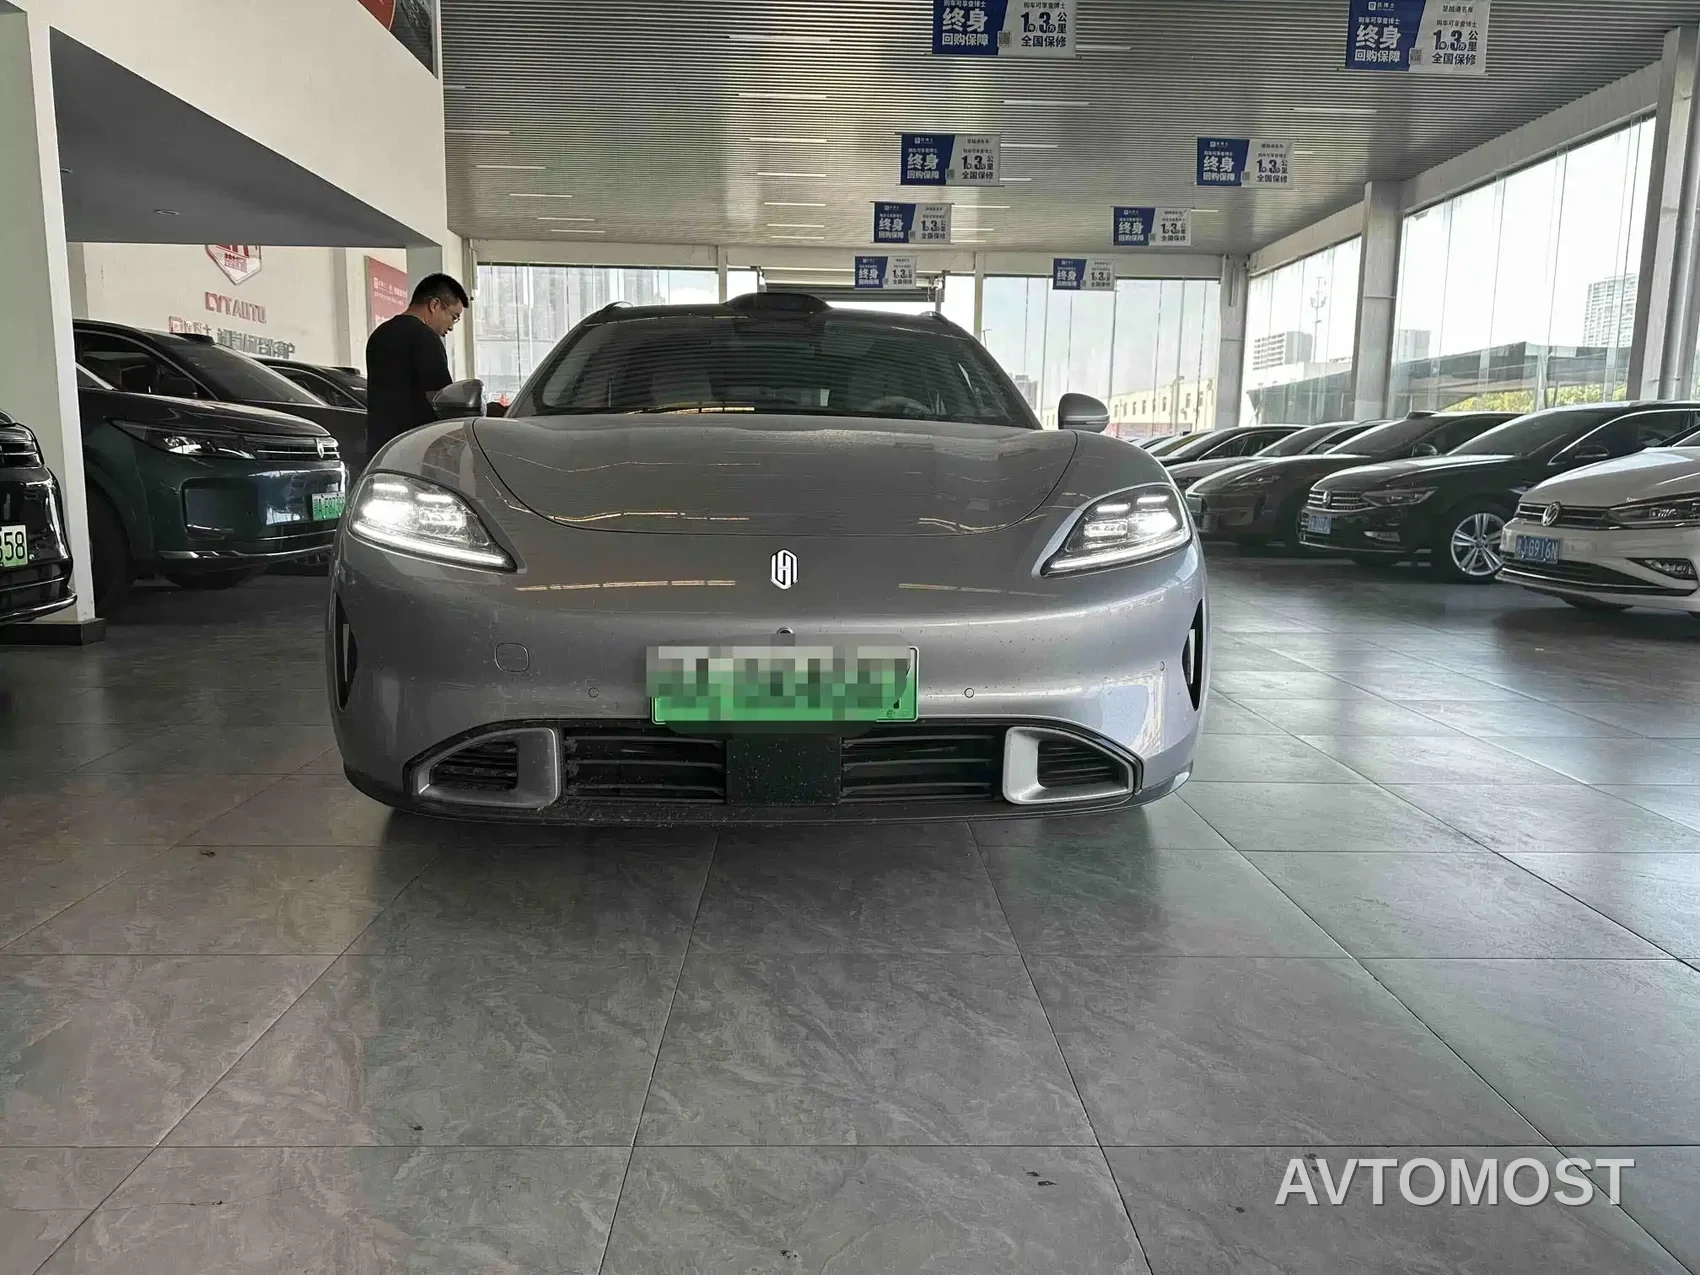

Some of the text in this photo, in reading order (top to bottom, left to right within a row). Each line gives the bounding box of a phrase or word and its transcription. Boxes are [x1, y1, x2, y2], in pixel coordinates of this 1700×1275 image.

[943, 8, 988, 32] 终身
[942, 33, 989, 46] 回购保障
[1021, 35, 1067, 48] 全国保修
[1356, 24, 1401, 49] 终身
[1354, 49, 1400, 63] 回购保障
[1431, 53, 1477, 65] 全国保修
[907, 153, 939, 170] 终身
[1203, 155, 1235, 172] 终身
[961, 171, 993, 180] 全国保修
[1256, 174, 1288, 183] 全国保修
[878, 217, 904, 231] 终身
[1118, 221, 1144, 234] 终身
